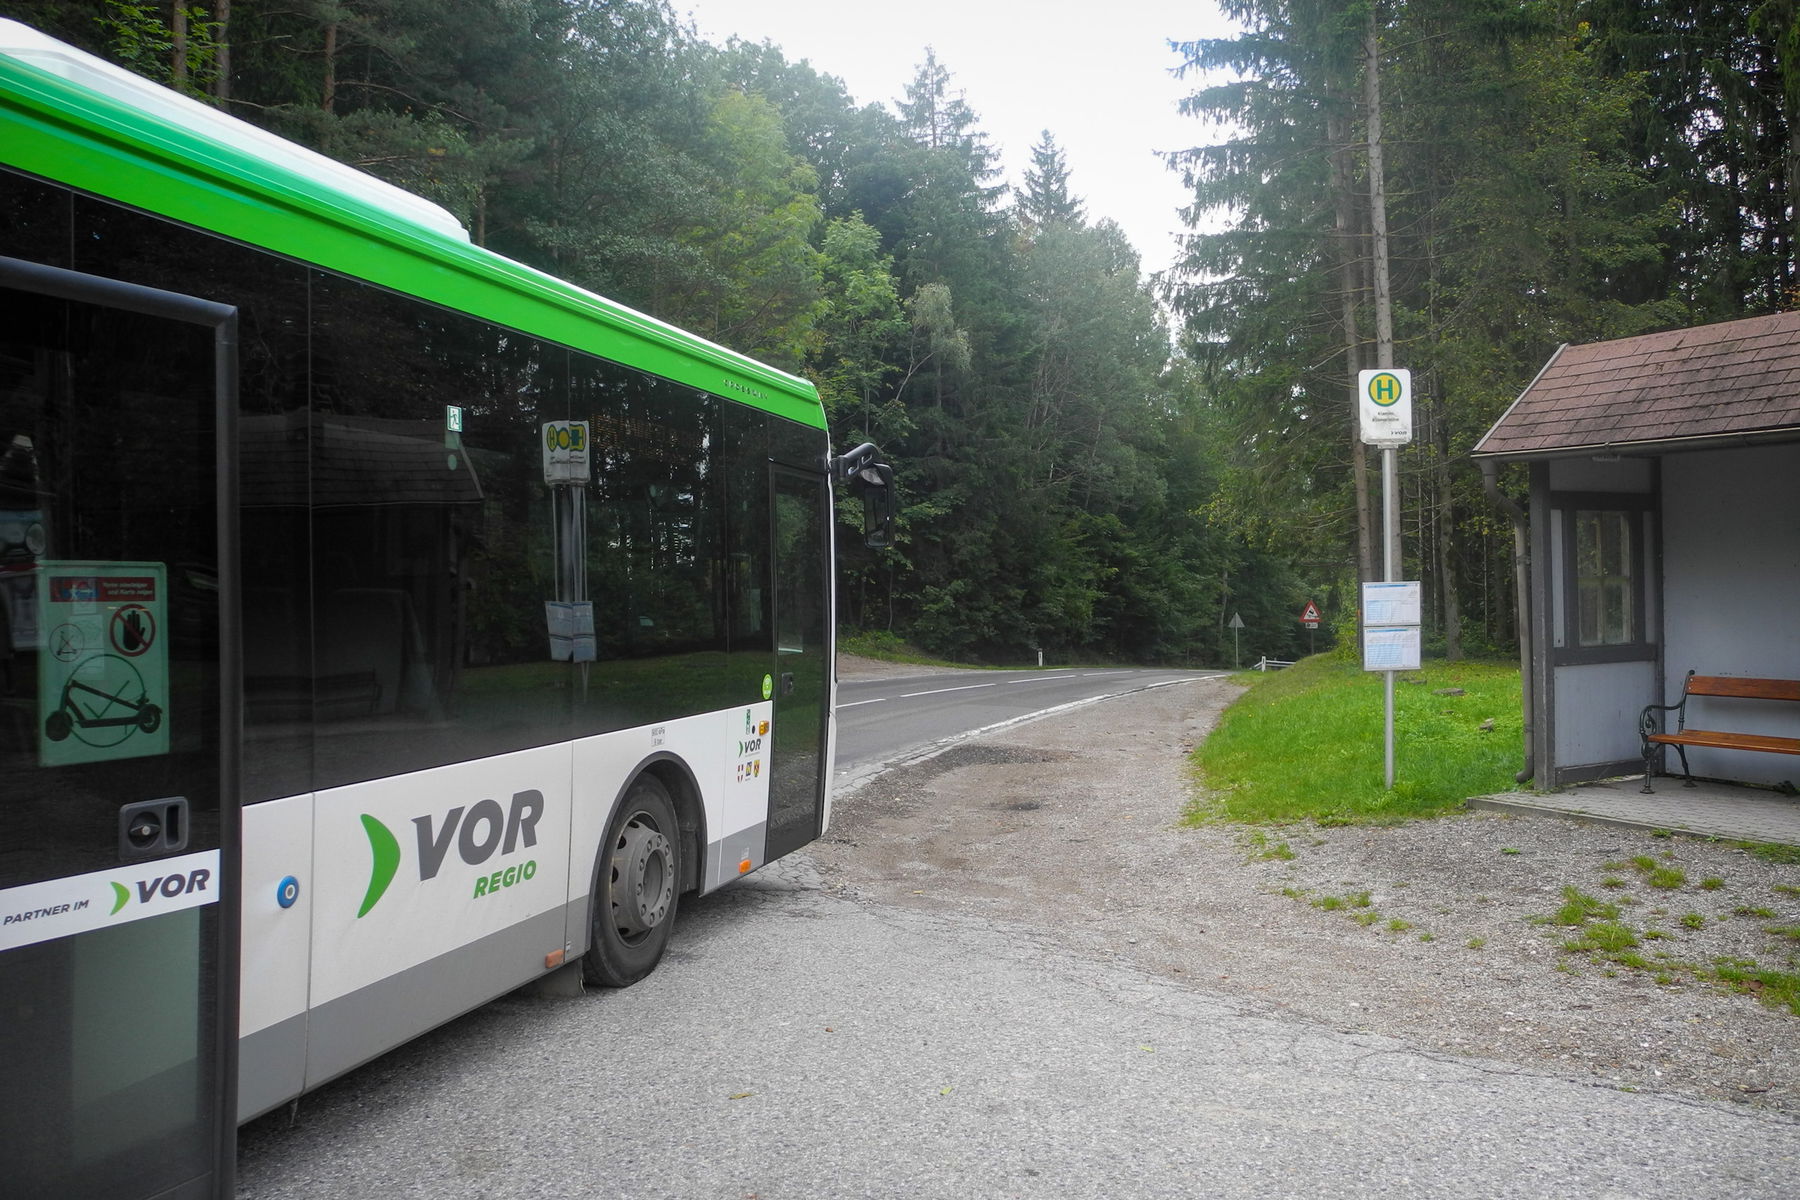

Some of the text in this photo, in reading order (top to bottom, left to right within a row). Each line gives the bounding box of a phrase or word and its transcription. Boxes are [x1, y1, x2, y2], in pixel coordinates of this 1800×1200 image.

[1376, 379, 1394, 400] H
[744, 738, 762, 754] VOR
[410, 789, 545, 882] VOR
[3, 868, 211, 926] PARTNER IM VOR
[473, 860, 537, 899] REGIO
